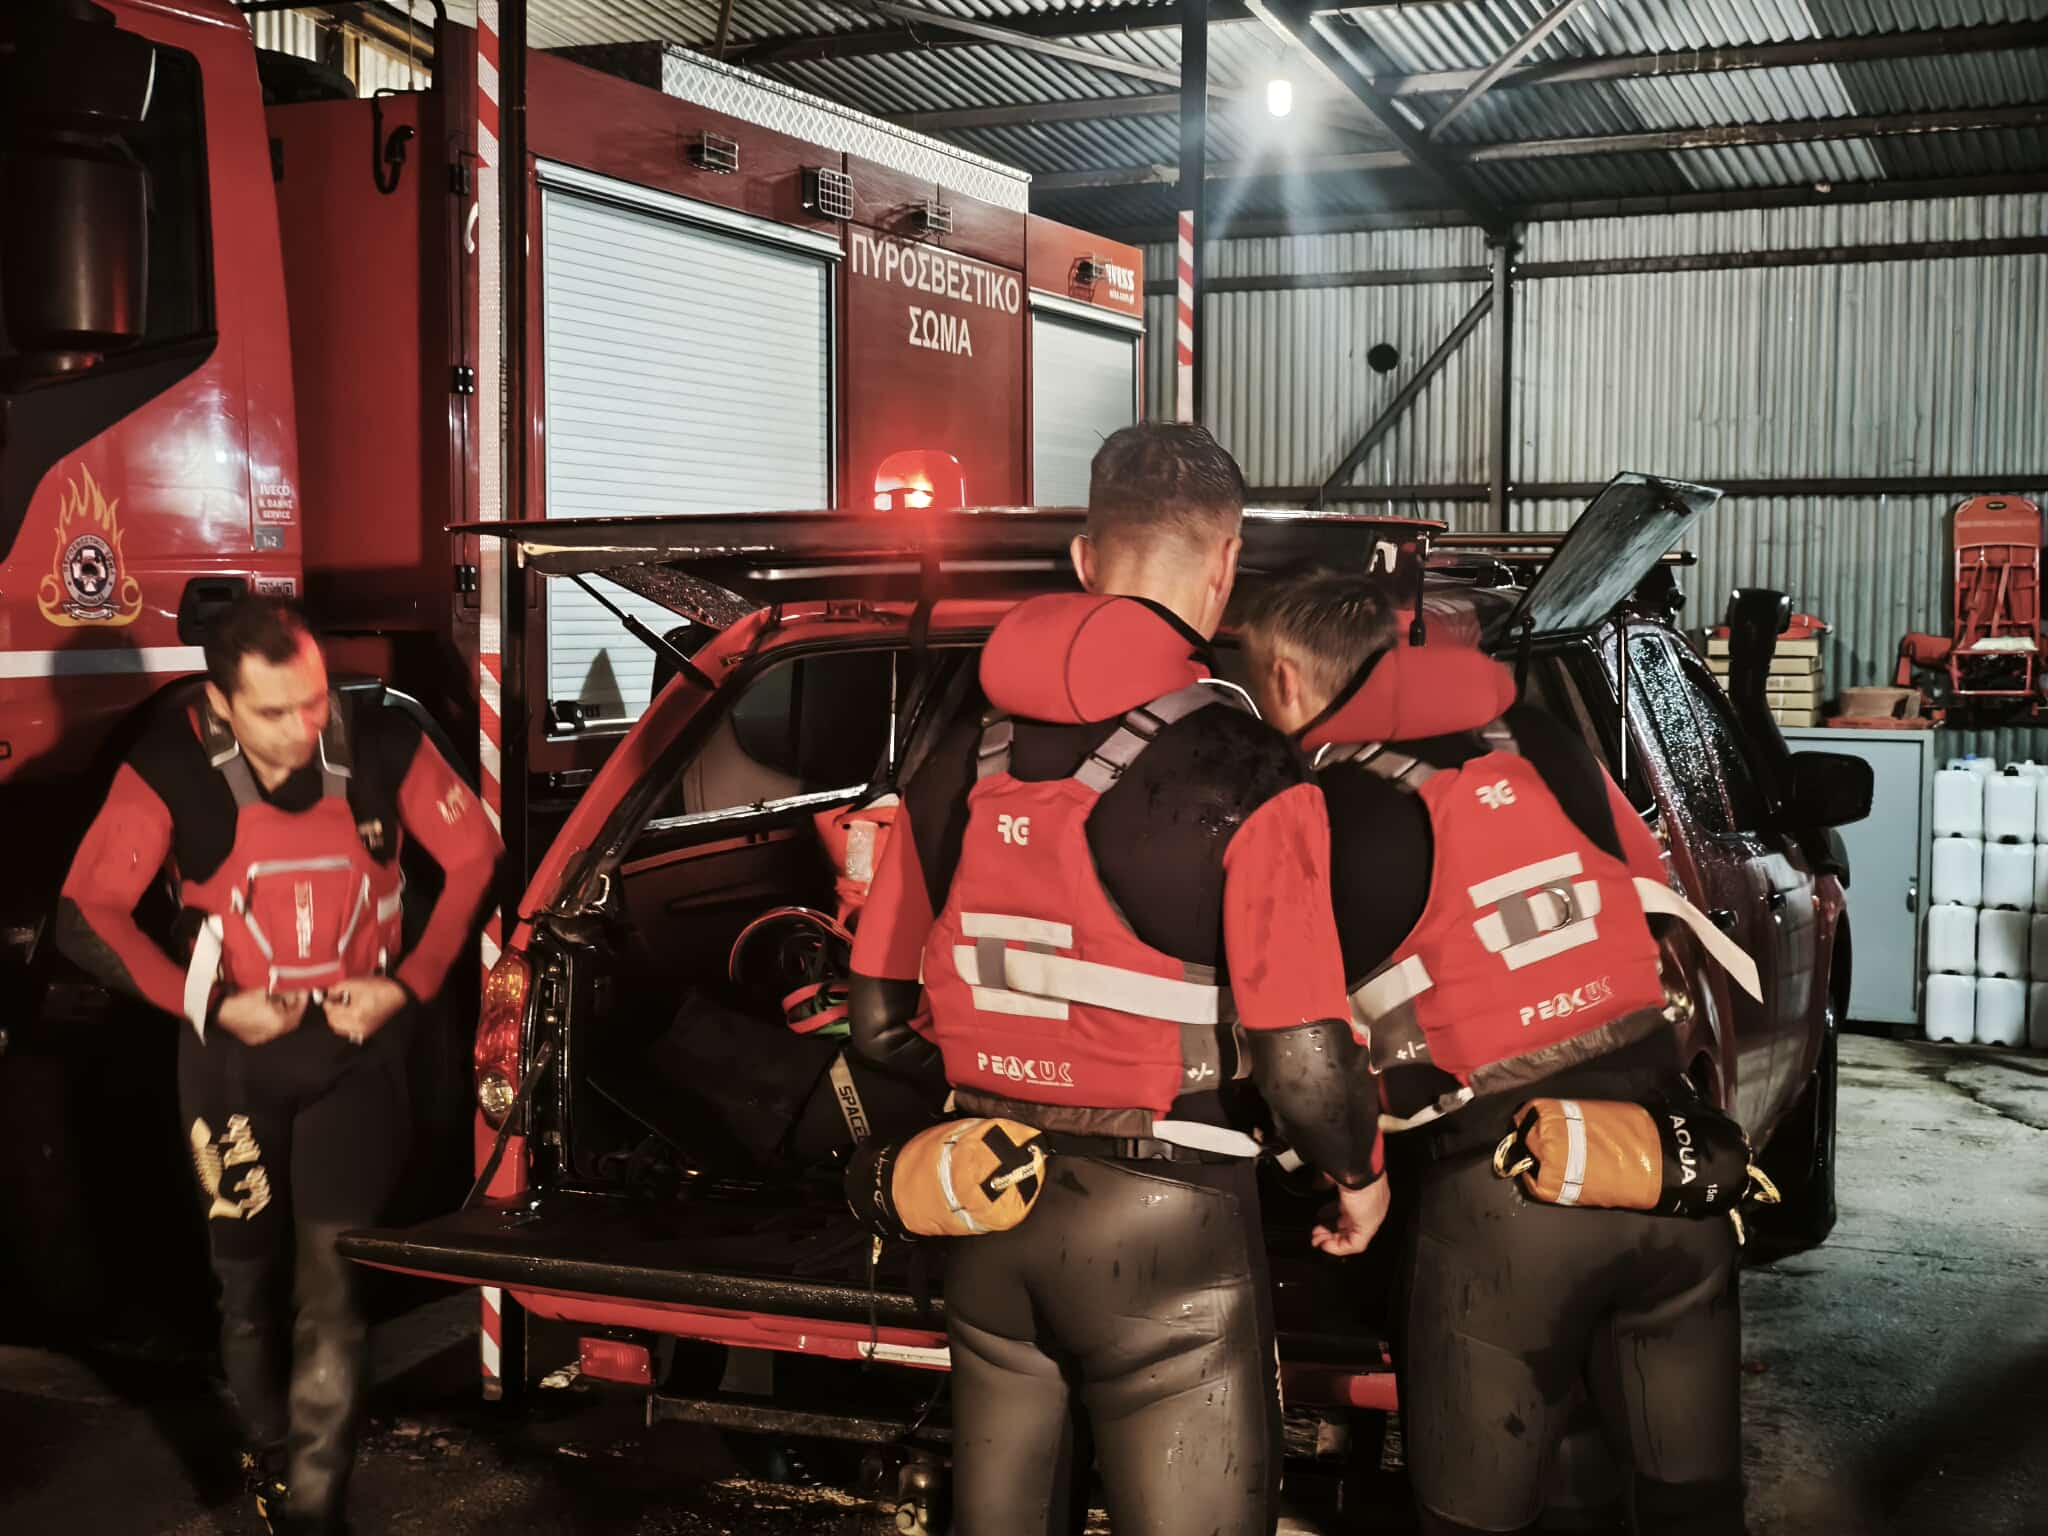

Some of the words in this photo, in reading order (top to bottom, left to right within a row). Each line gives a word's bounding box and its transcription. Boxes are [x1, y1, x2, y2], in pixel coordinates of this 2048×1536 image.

[851, 232, 1020, 314] ΠΥΡΟΣΒΕΣΤΙΚΟ
[908, 306, 972, 357] ΣΩΜΑ
[260, 484, 290, 496] IVECO
